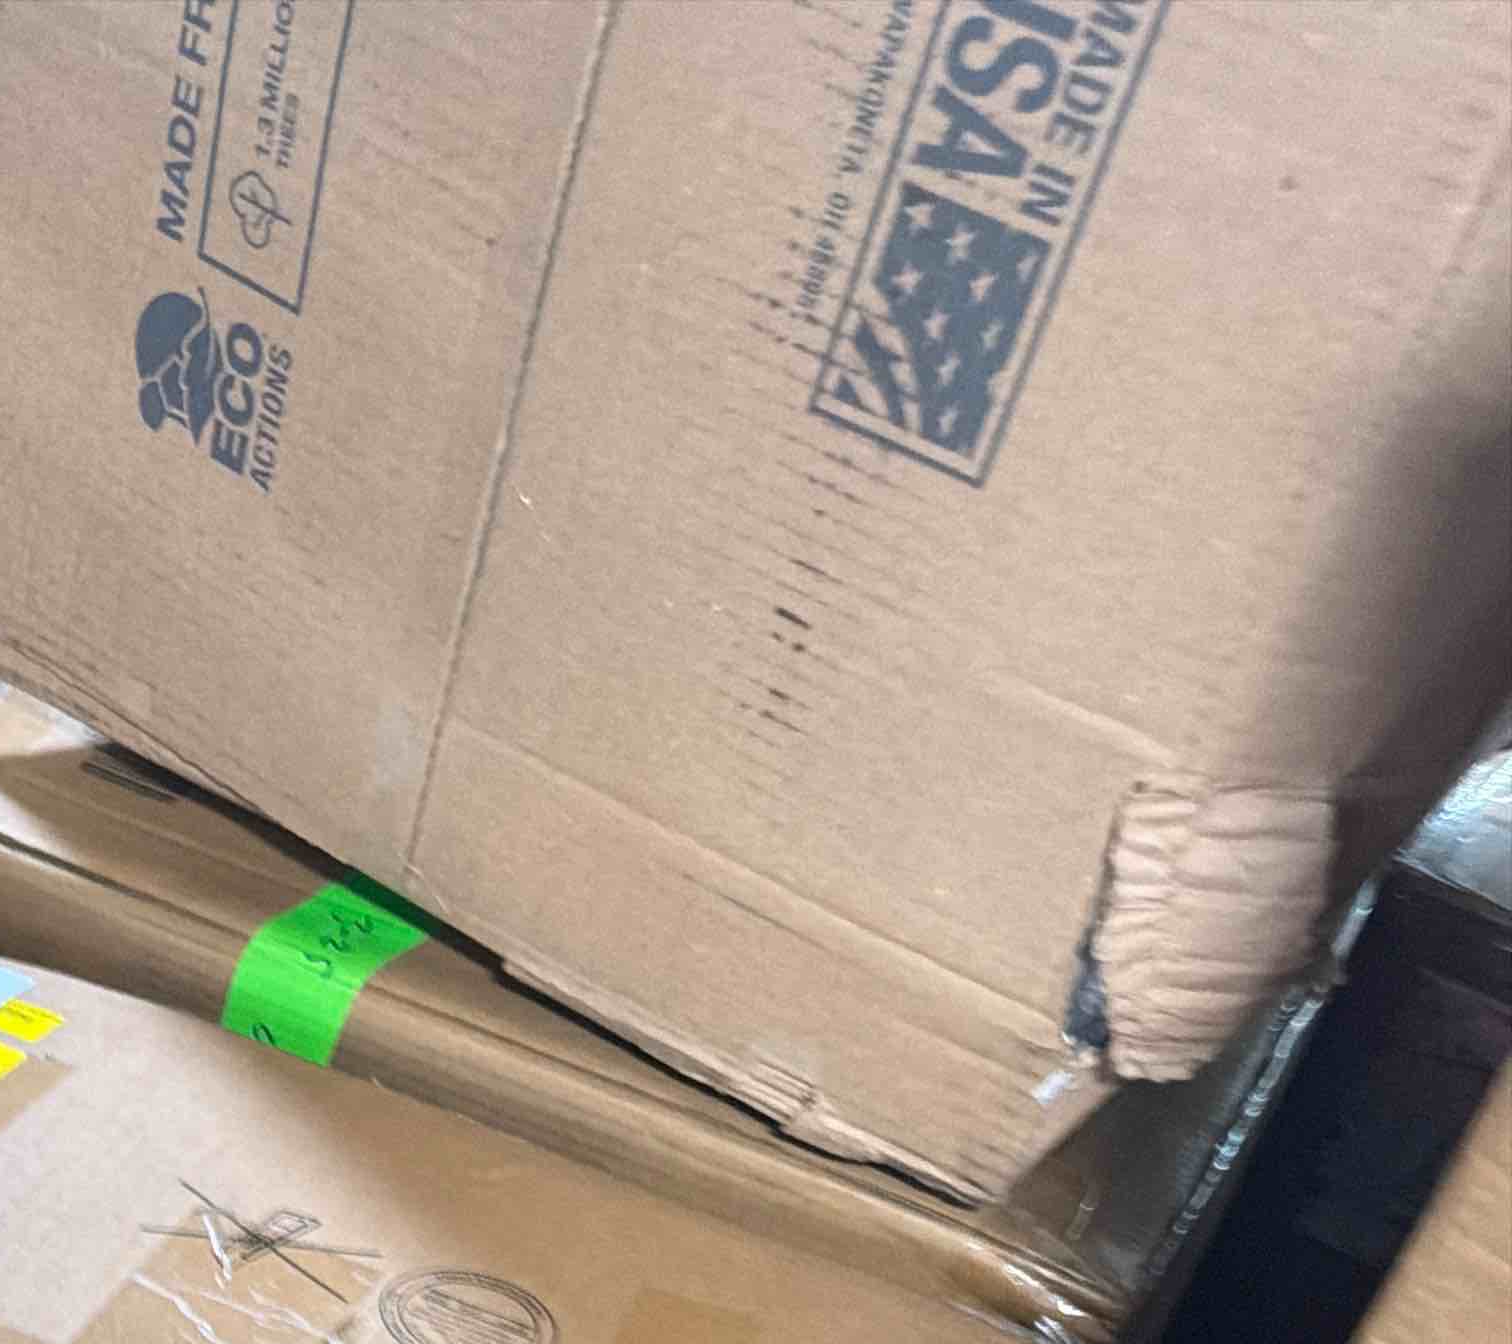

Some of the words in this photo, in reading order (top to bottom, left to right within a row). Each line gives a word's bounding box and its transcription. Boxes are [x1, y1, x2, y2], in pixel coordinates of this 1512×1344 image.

[155, 74, 207, 243] MADE
[1018, 163, 1077, 227] IN
[210, 322, 265, 475] ECO
[249, 344, 295, 492] ACTIONS
